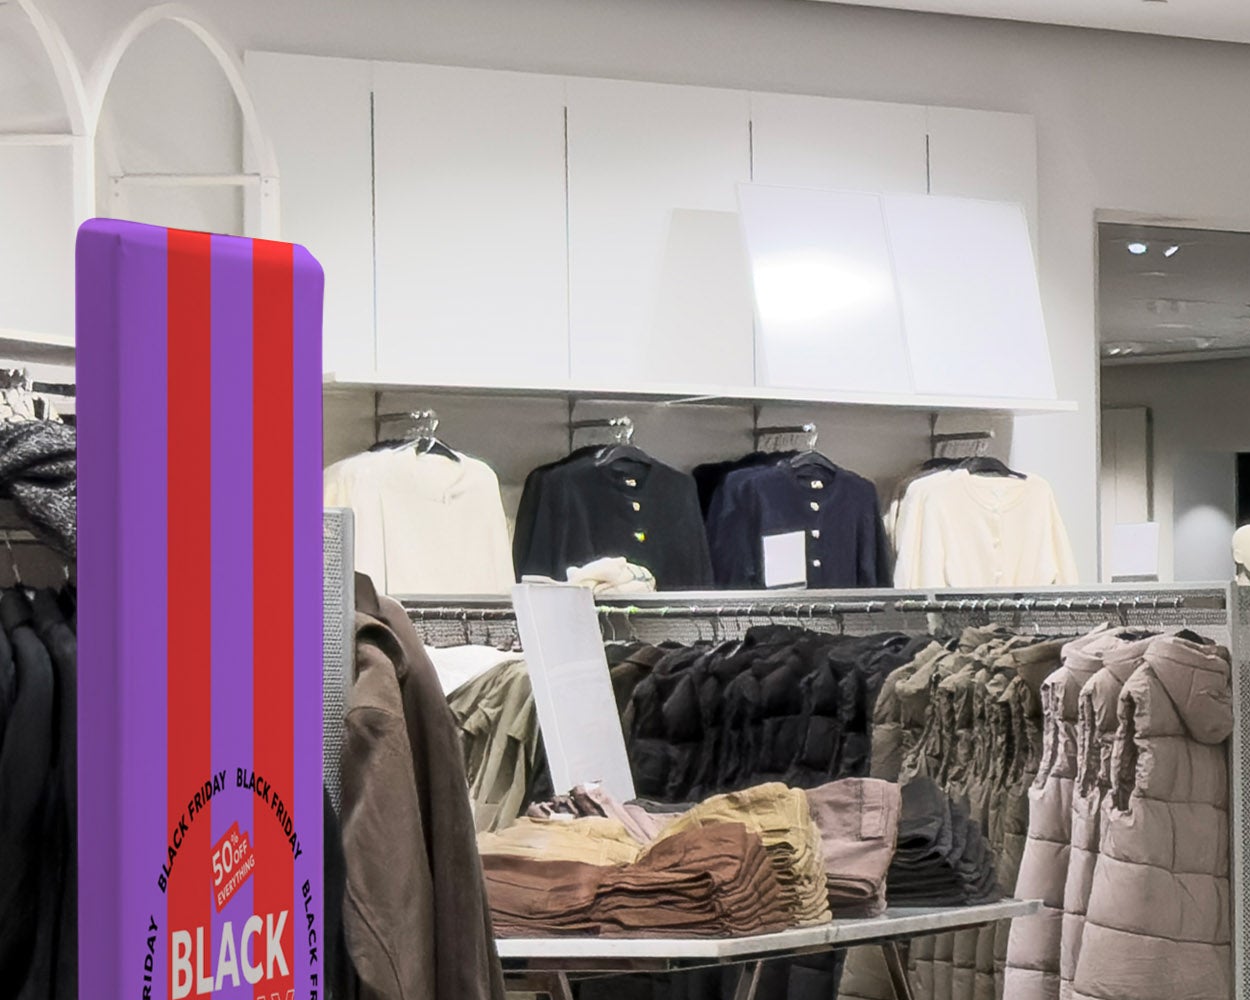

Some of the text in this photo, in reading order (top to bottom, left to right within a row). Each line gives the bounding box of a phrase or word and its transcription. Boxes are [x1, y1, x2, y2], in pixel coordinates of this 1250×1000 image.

[158, 770, 227, 893] BLACK FRIDAY
[233, 839, 247, 865] OFF
[236, 768, 303, 860] BLACK FRIDAY
[217, 855, 255, 906] EVERYTHING
[301, 879, 318, 966] BLACK
[172, 910, 290, 1000] BLACK
